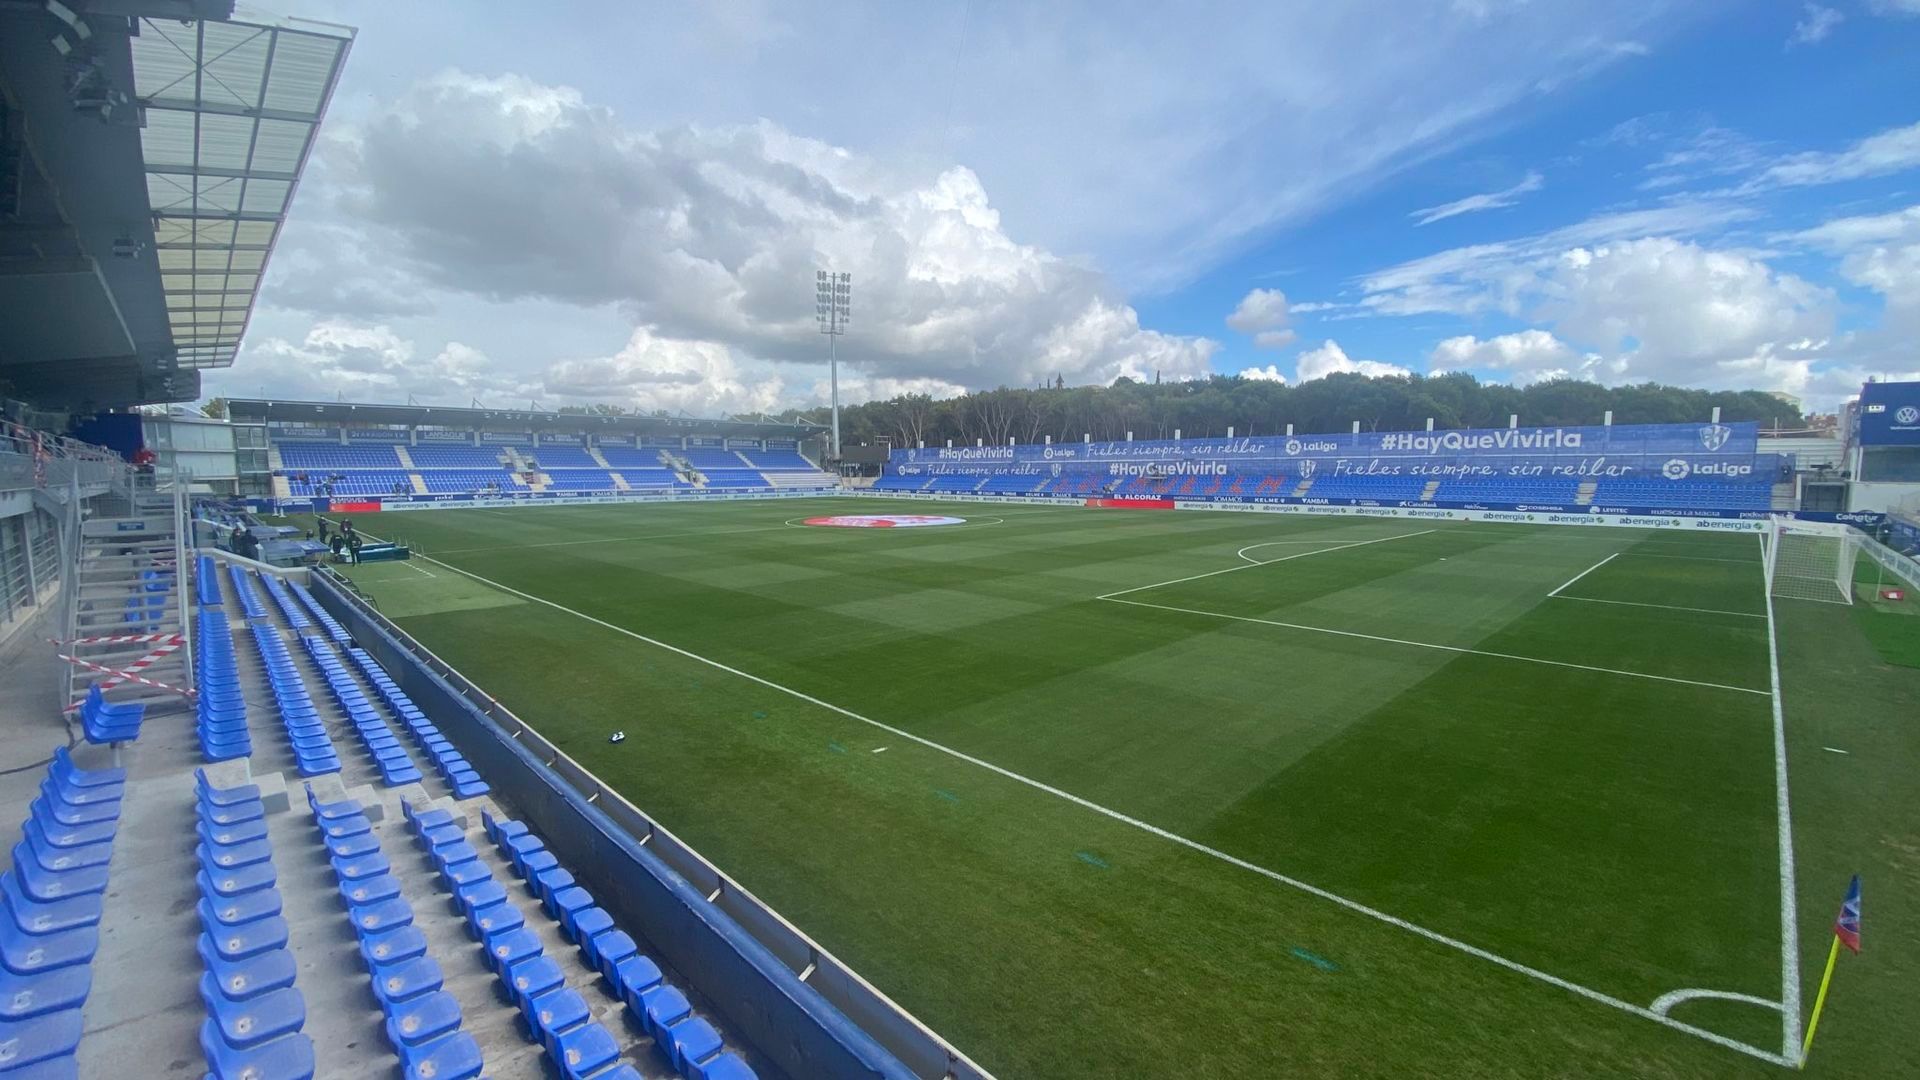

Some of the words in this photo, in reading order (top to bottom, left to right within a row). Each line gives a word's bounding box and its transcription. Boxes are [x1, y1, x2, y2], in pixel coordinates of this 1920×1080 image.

[1086, 443, 1127, 457] Fieles
[1132, 445, 1185, 459] siempre,
[1191, 443, 1211, 454] sin
[1217, 438, 1265, 454] reblar
[1303, 441, 1338, 452] LaLiga
[1381, 429, 1582, 454] #HayQueVivirla
[939, 447, 1013, 461] #HayQueVivirla
[927, 464, 956, 475] Fieles
[1011, 463, 1041, 476] reblar
[1334, 459, 1401, 477] Fieles
[1410, 462, 1498, 479] siempre,
[1508, 461, 1543, 476] sin
[1551, 457, 1633, 477] reblar
[1693, 462, 1751, 477] LaLiga
